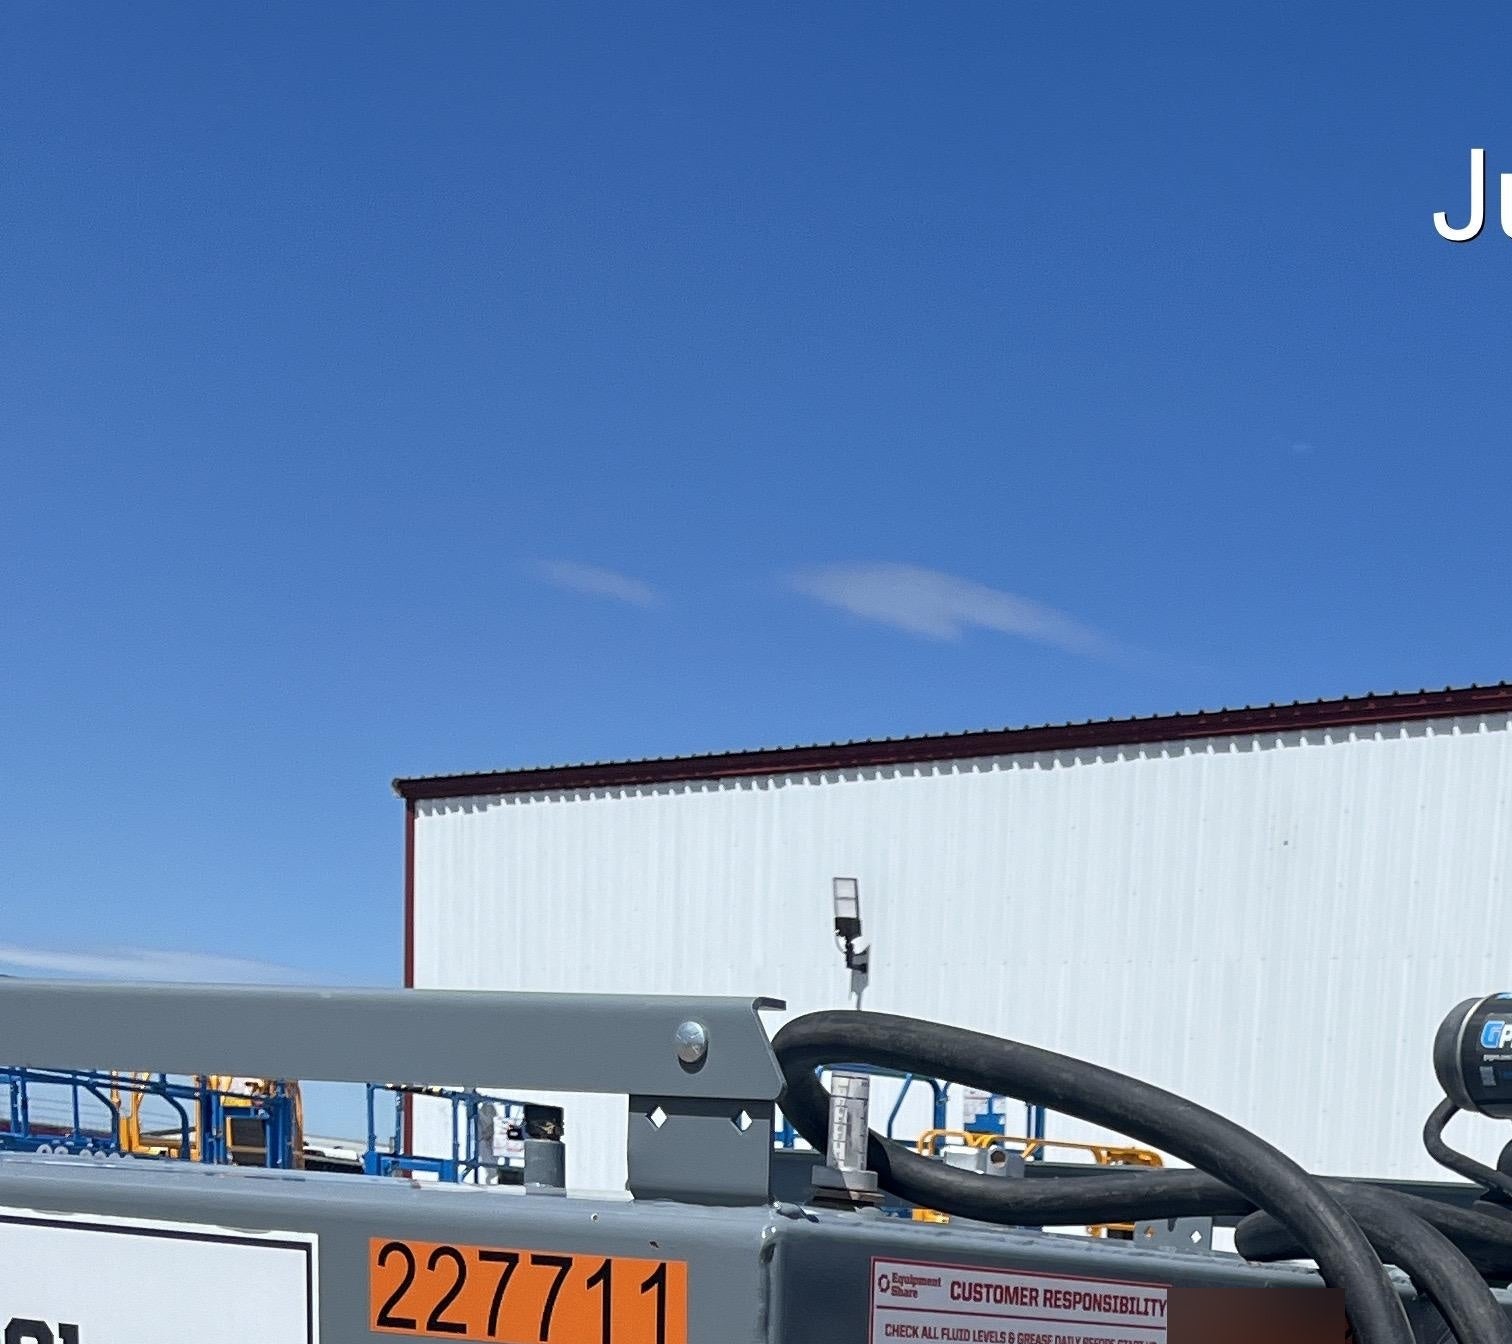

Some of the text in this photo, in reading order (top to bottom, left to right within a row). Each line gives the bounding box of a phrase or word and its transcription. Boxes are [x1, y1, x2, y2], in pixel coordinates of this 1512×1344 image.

[892, 1272, 942, 1288] Equipment
[891, 1284, 918, 1298] Share
[950, 1280, 1167, 1317] CUSTOMER RESPONSIBILITY
[885, 1323, 920, 1339] CHECK
[921, 1326, 939, 1340] ALL
[941, 1327, 970, 1342] FLUID
[972, 1328, 1006, 1344] LEVELS
[1008, 1331, 1015, 1344] &
